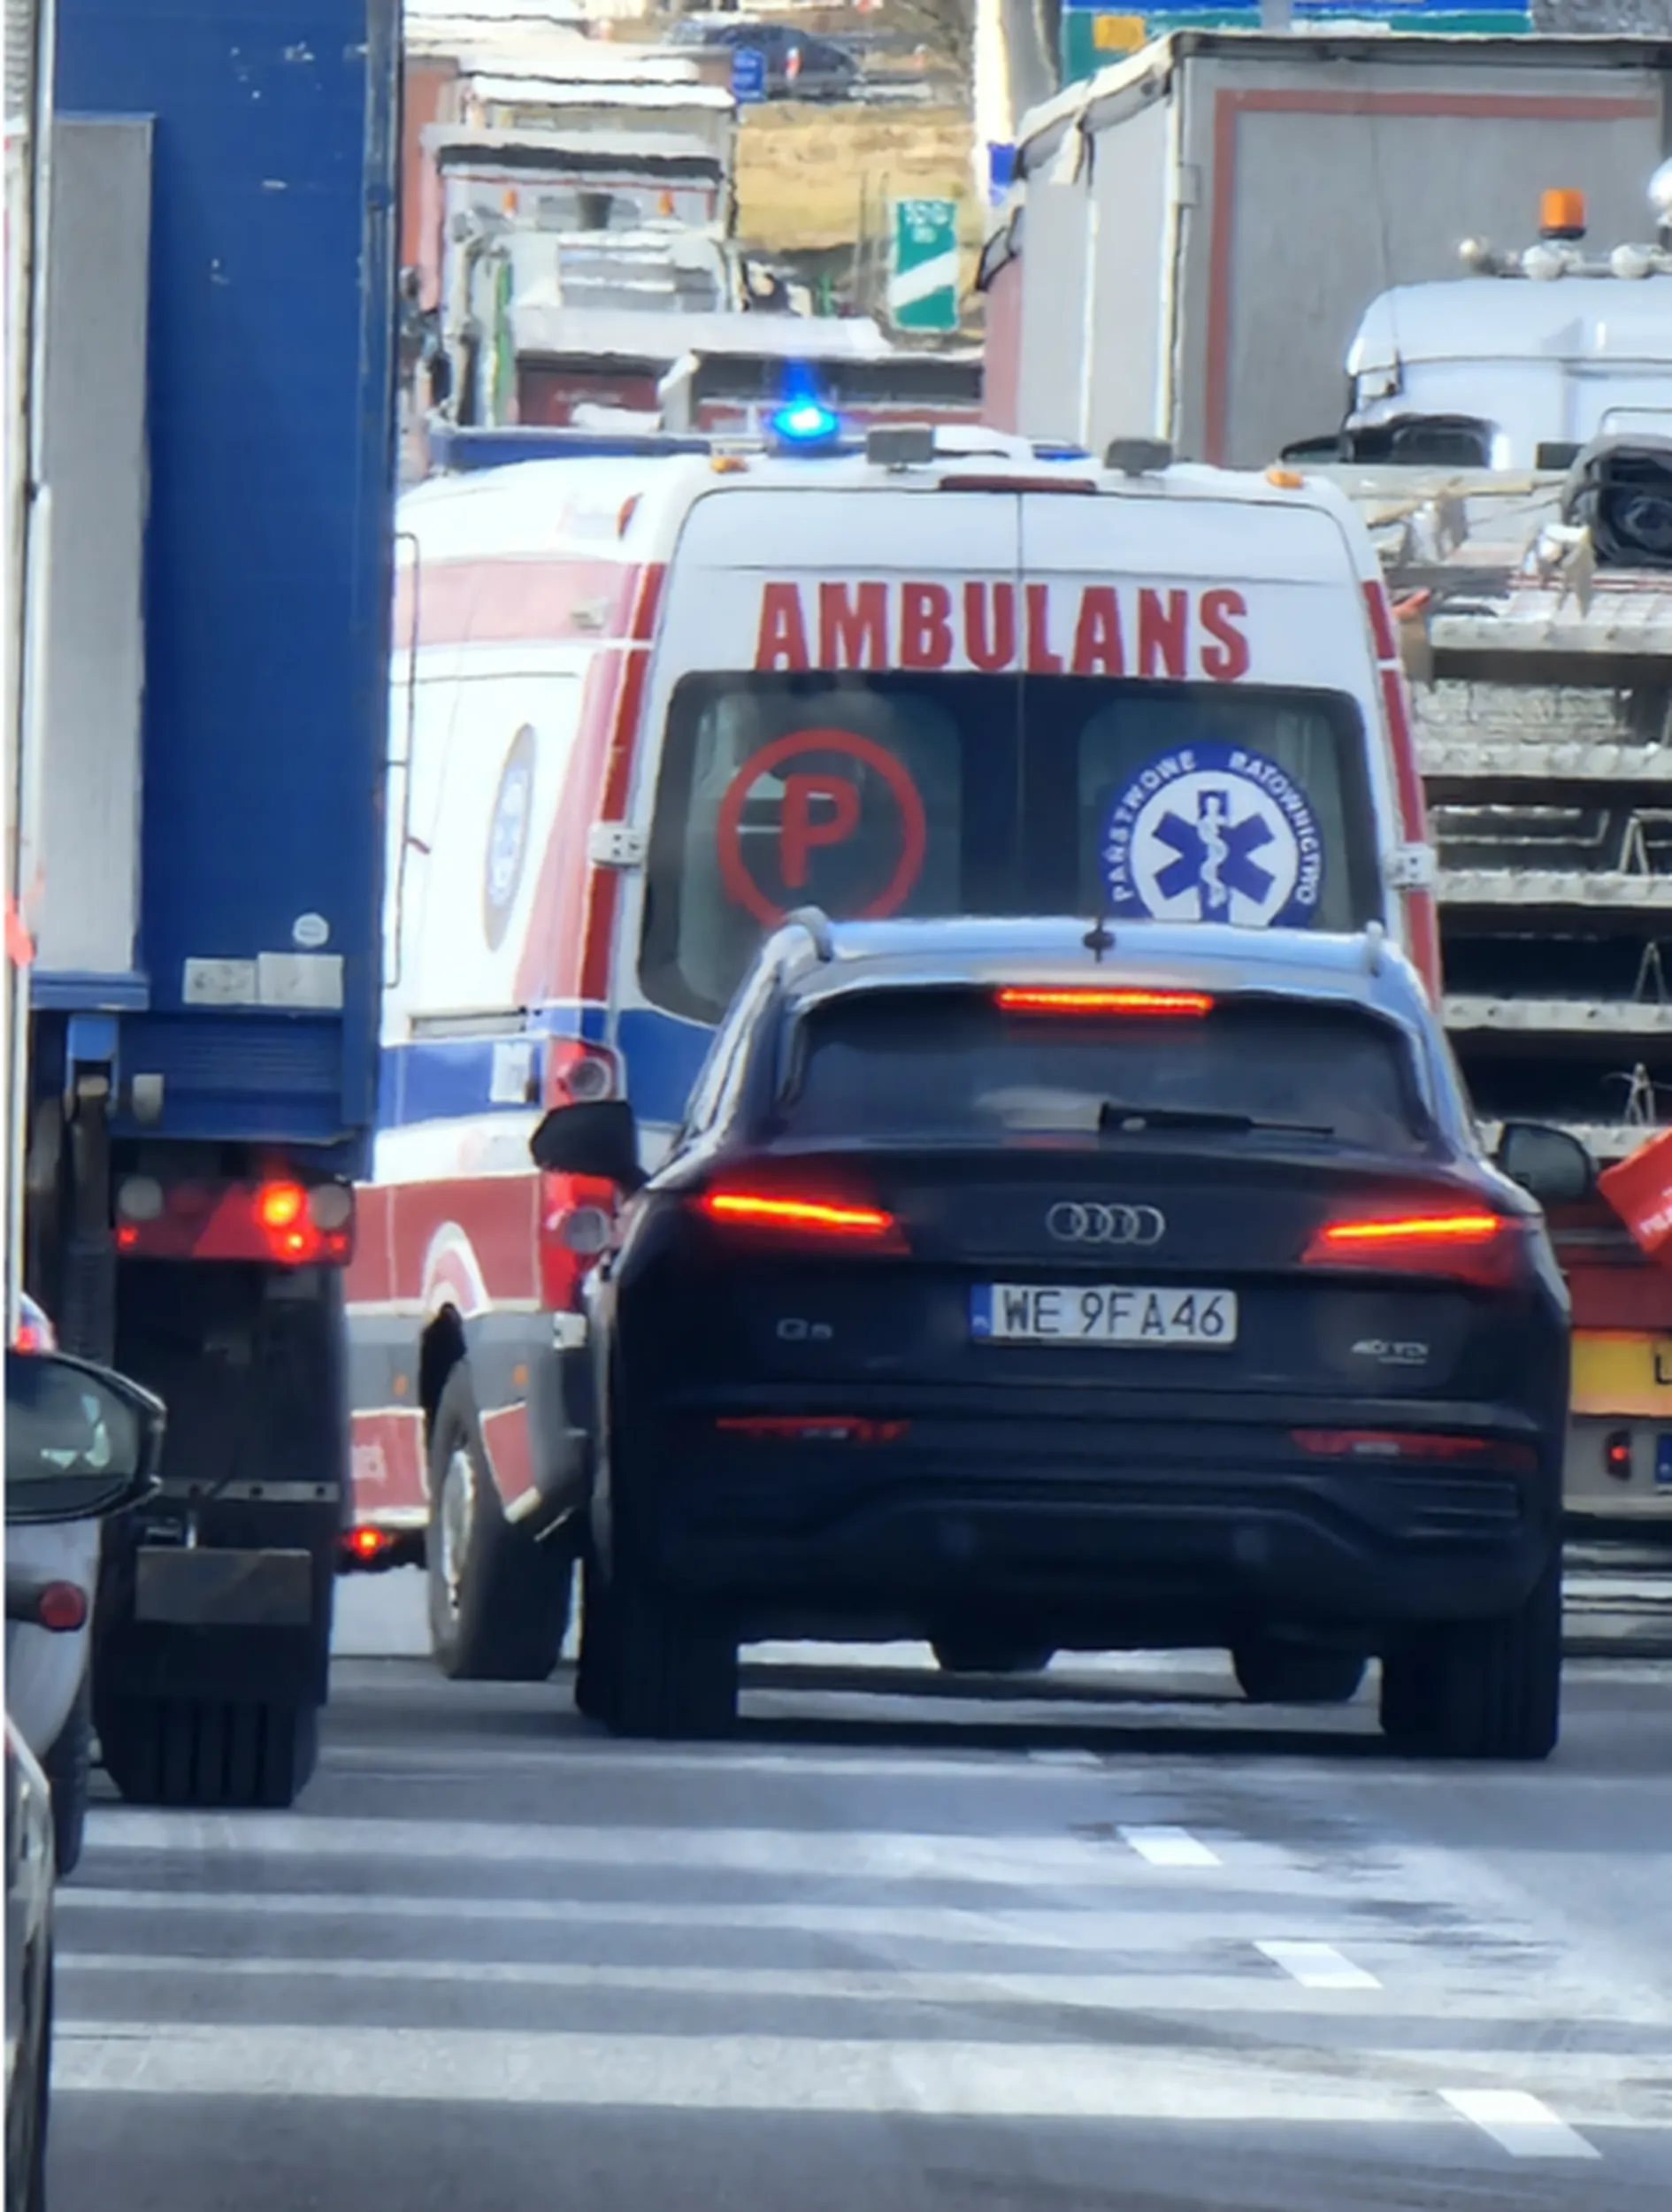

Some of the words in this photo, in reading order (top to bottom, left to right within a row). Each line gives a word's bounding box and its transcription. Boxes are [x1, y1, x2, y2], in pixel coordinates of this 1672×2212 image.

[755, 581, 1250, 684] AMBULANS
[779, 772, 861, 888] P
[1002, 1289, 1061, 1333] WE
[1079, 1291, 1224, 1337] 9FA46
